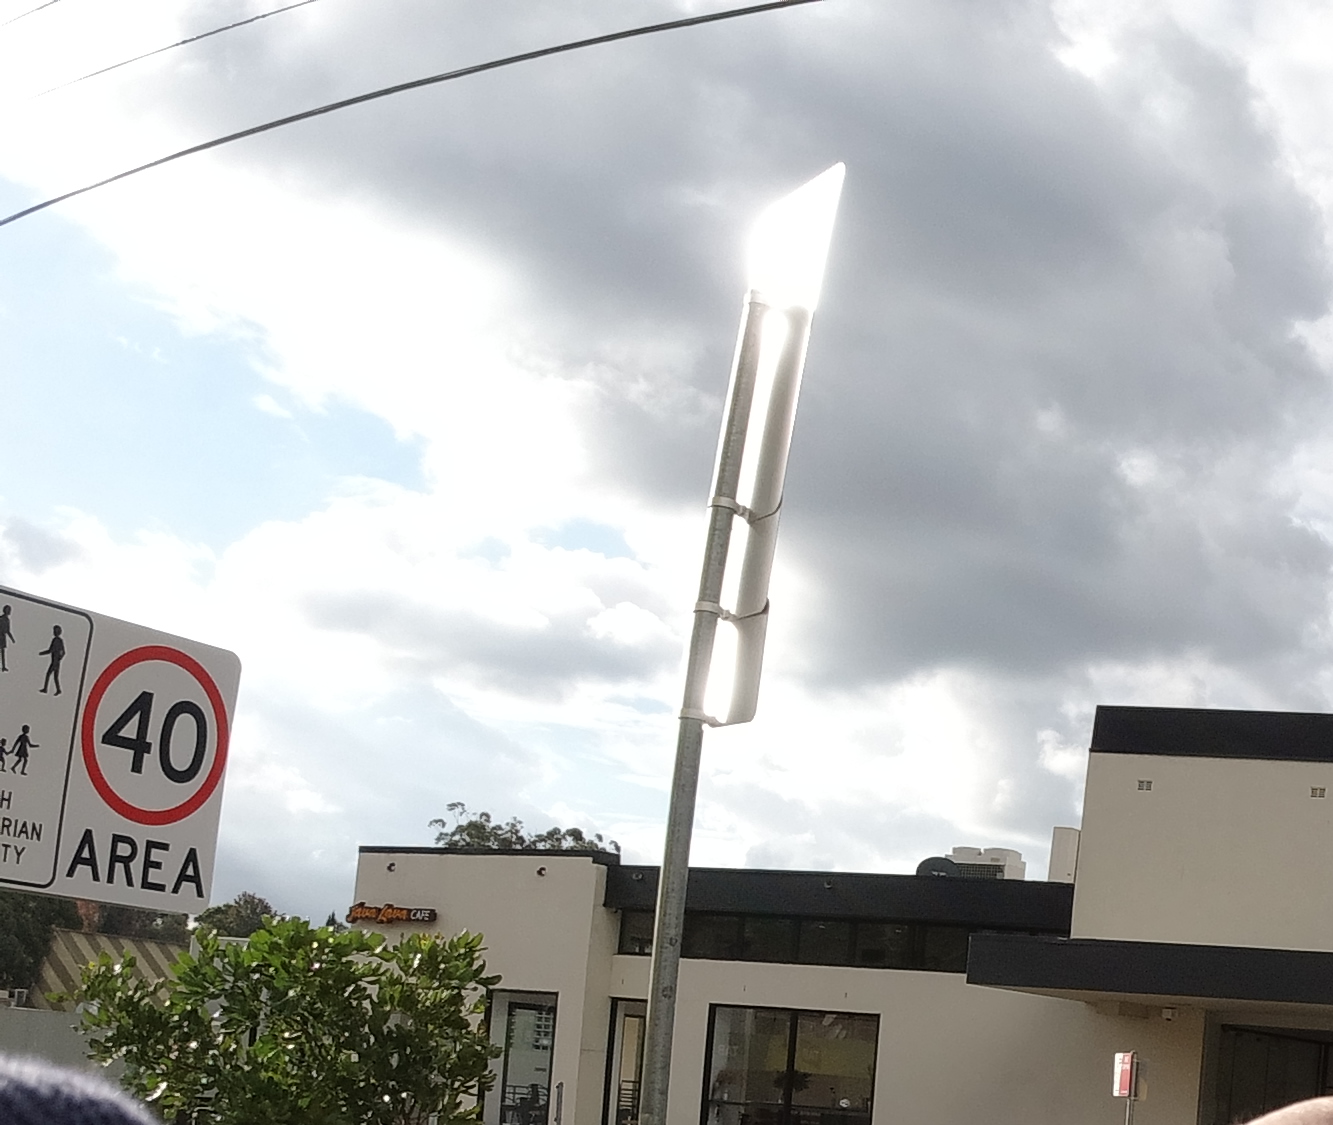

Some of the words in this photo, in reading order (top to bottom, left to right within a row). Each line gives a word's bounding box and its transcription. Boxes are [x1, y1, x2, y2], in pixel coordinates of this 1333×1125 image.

[101, 690, 208, 784] 40
[66, 828, 204, 899] AREA
[410, 909, 431, 920] CAFE
